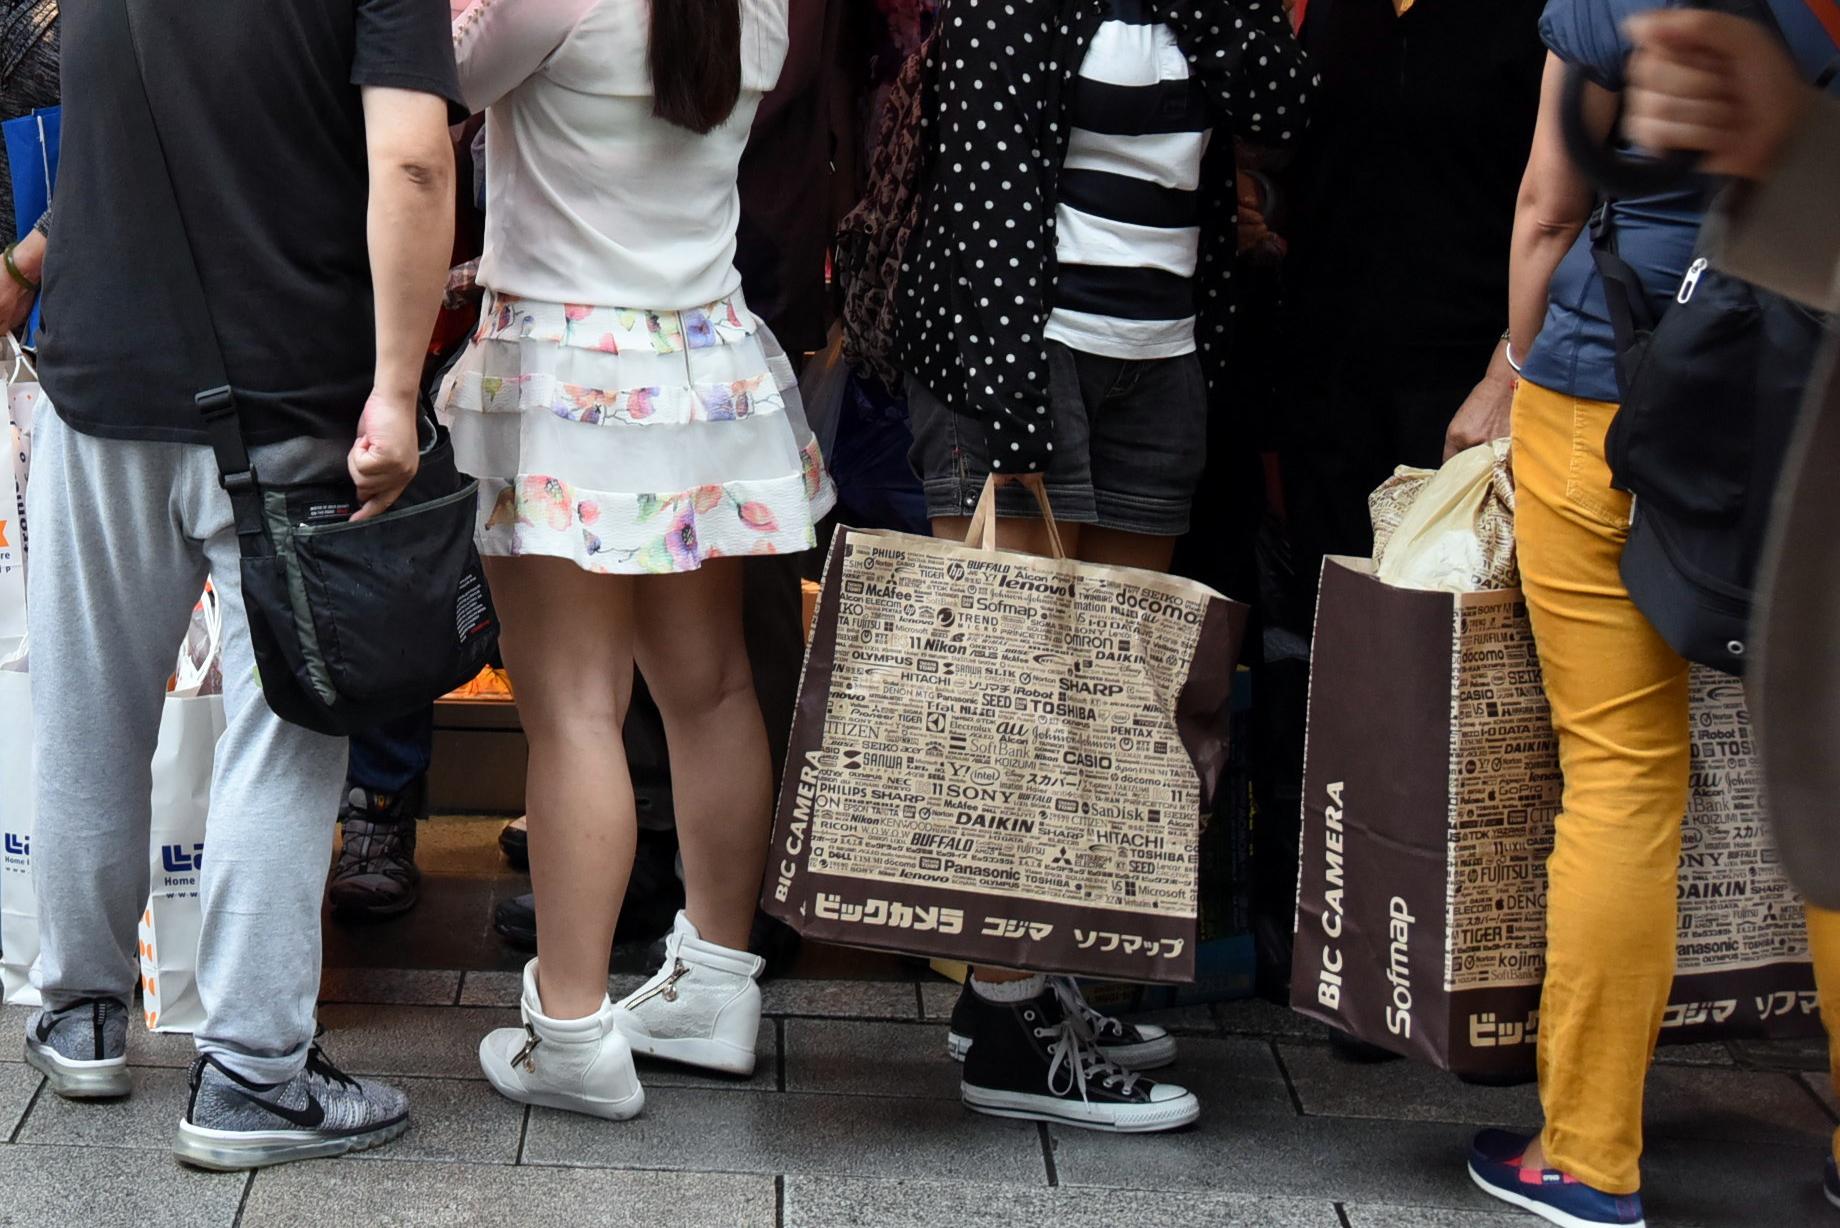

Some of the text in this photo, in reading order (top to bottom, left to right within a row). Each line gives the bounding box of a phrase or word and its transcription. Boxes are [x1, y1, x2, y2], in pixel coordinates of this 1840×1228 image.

[872, 548, 906, 560] PHILIPS
[967, 560, 1011, 573] BUFFALO
[866, 583, 912, 601] McAfee
[977, 598, 1037, 619] Sofmap
[958, 613, 998, 626] TREND
[924, 639, 967, 656] Nikon
[852, 651, 913, 666] OLYMPUS
[901, 672, 951, 686] HITACHI
[1508, 670, 1543, 685] SEIK
[1059, 677, 1124, 697] SHARP
[1030, 699, 1096, 721] TOSHIBA
[820, 783, 867, 798] PHILIPS
[870, 790, 925, 804] SHARP
[946, 784, 1015, 804] SONY
[1091, 803, 1144, 821] SanDisk
[775, 750, 822, 903] BIC CAMERA
[955, 811, 1035, 834] DAIKIN
[910, 832, 975, 853] BUFFALO
[1097, 830, 1164, 849] HITACHI
[5, 856, 24, 865] Home
[1130, 848, 1185, 863] TOSHIBA
[899, 869, 949, 884] lenovo
[944, 859, 1021, 882] Panasonic
[165, 876, 195, 886] Home
[1318, 781, 1344, 1010] BIC CAMERA
[815, 892, 1185, 959] ビックカメラ コジマ ソフマップ
[1461, 926, 1503, 944] TIGER
[1386, 896, 1415, 1040] Sofmap
[1662, 998, 1738, 1027] コジマ
